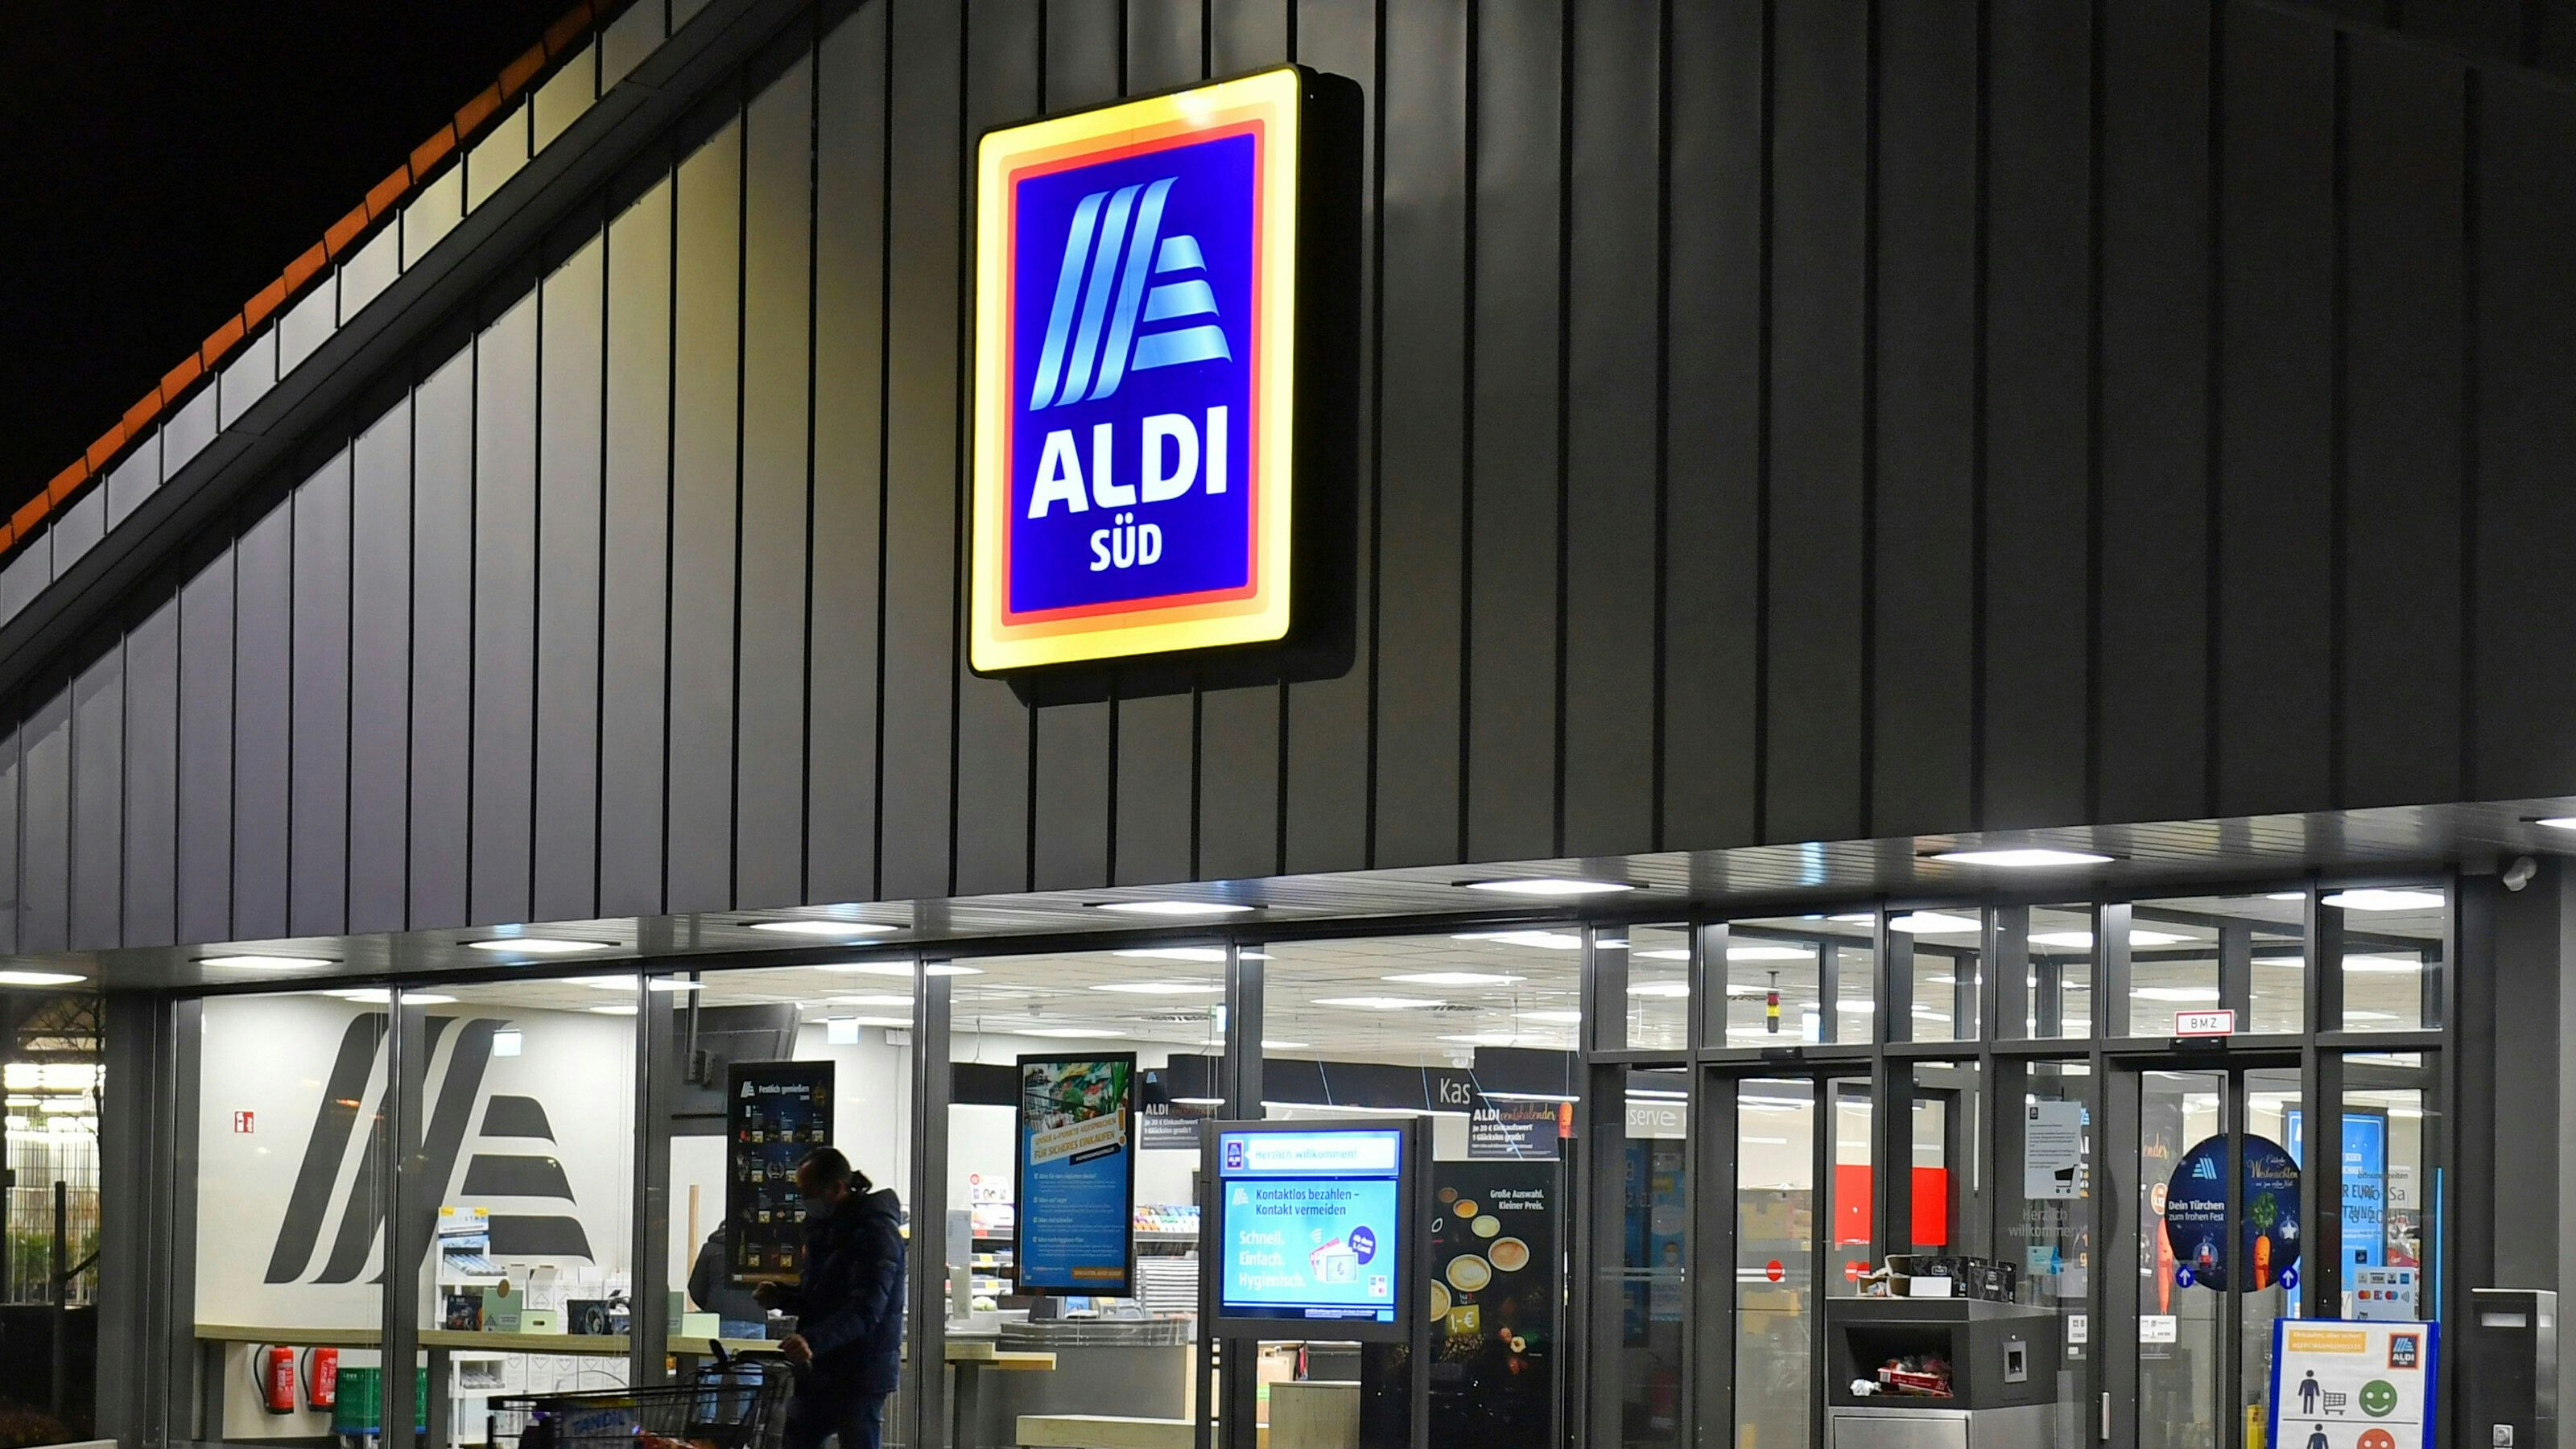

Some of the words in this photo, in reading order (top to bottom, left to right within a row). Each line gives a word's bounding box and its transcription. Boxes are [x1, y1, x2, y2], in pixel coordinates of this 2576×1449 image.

[1027, 406, 1228, 519] ALDI
[1090, 514, 1162, 572] SÜD
[2190, 1018, 2217, 1029] BMZ
[1256, 1188, 1306, 1200] Kontaktlos
[1308, 1188, 1352, 1200] bezahlen
[1490, 1189, 1511, 1199] Große
[1512, 1189, 1544, 1199] Auswahl.
[2389, 1187, 2405, 1201] Sa
[1256, 1204, 1292, 1216] Kontakt
[1295, 1203, 1346, 1215] vermeiden
[1499, 1200, 1523, 1210] Kleiner
[1524, 1200, 1544, 1210] Preis.
[2169, 1199, 2188, 1210] Dein
[2189, 1199, 2224, 1210] Türchen
[2023, 1208, 2067, 1220] Herzlich
[2169, 1213, 2184, 1221] zum
[2185, 1212, 2208, 1221] frohen
[2210, 1212, 2224, 1221] Fest
[1240, 1230, 1285, 1245] Schnell.
[1240, 1250, 1285, 1265] Einfach.
[1240, 1273, 1307, 1290] Hygienisch.
[2392, 1353, 2415, 1361] ALDI
